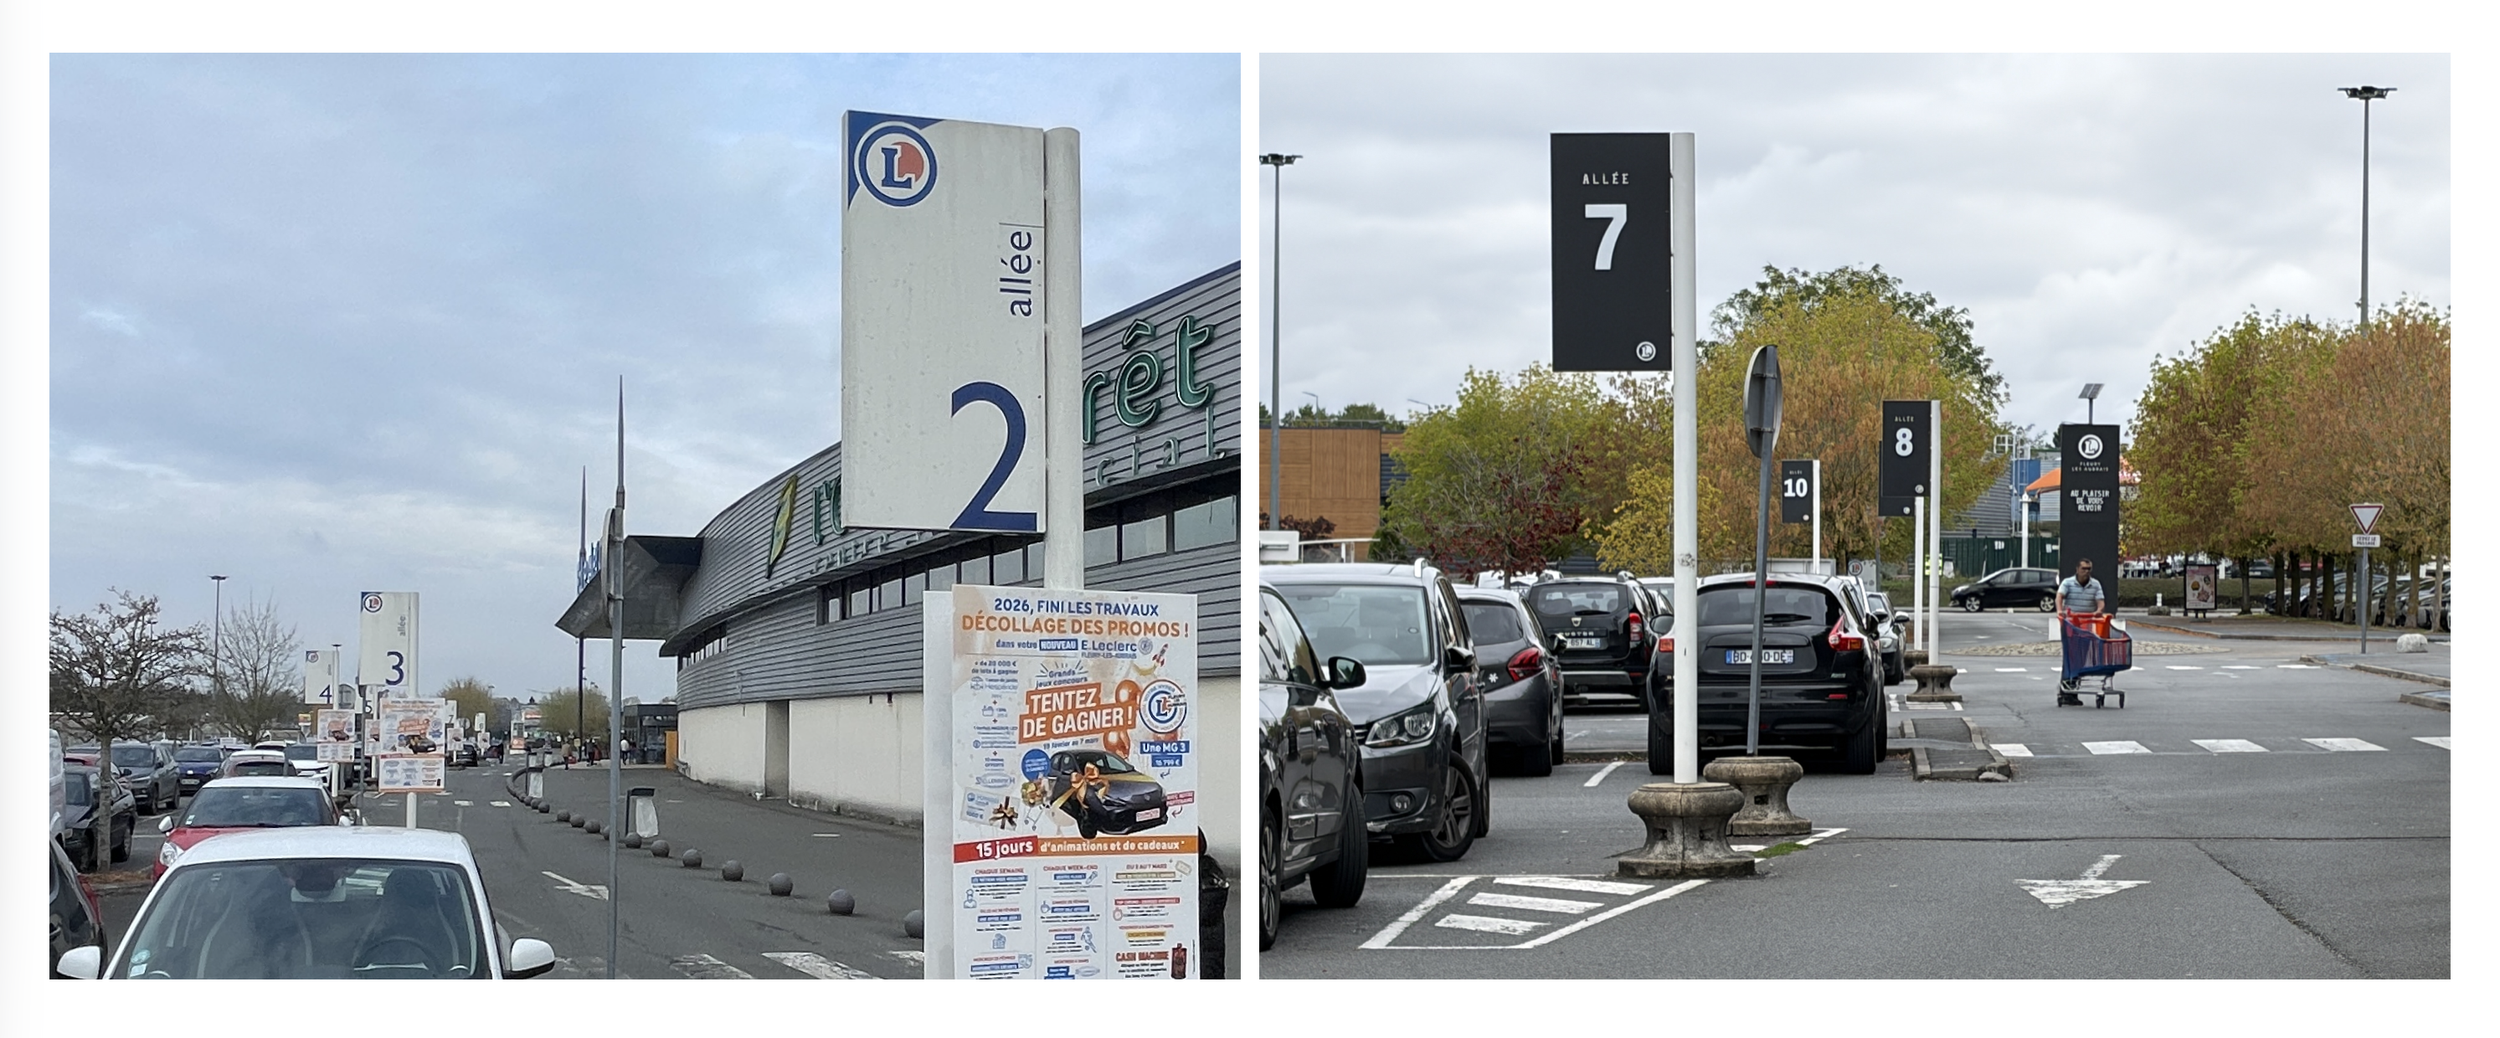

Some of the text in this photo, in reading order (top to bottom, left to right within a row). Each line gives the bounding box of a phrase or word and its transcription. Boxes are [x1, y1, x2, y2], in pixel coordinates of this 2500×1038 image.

[1582, 171, 1630, 185] ALLÉE
[1585, 204, 1628, 271] 7
[1000, 231, 1032, 317] allée
[1083, 315, 1215, 445] rêt
[1895, 427, 1913, 456] 8
[949, 381, 1037, 531] 2
[1783, 478, 1808, 497] 10
[2078, 504, 2102, 512] REVOIR
[994, 598, 1159, 616] 2026, FINI LES TRAVAUX
[962, 610, 1067, 635] DÉCOLLAGE
[1071, 619, 1104, 636] DES
[1107, 620, 1181, 637] PROMOS
[996, 639, 1015, 648] dans
[1017, 640, 1038, 649] votre
[1040, 640, 1076, 650] NOUVEAU
[385, 651, 404, 686] 3
[1049, 669, 1076, 678] Grands
[1035, 676, 1088, 689] jeux concours
[319, 684, 332, 704] 4
[1030, 688, 1097, 714] TENTEZ
[1023, 717, 1047, 739] DE
[1052, 707, 1124, 735] GAGNER
[1142, 742, 1186, 752] Une MG 3
[976, 842, 992, 858] 15
[994, 840, 1034, 860] jours
[1040, 841, 1108, 853] d'animations
[1110, 841, 1121, 851] et
[1123, 840, 1135, 851] de
[1116, 952, 1136, 962] CASH
